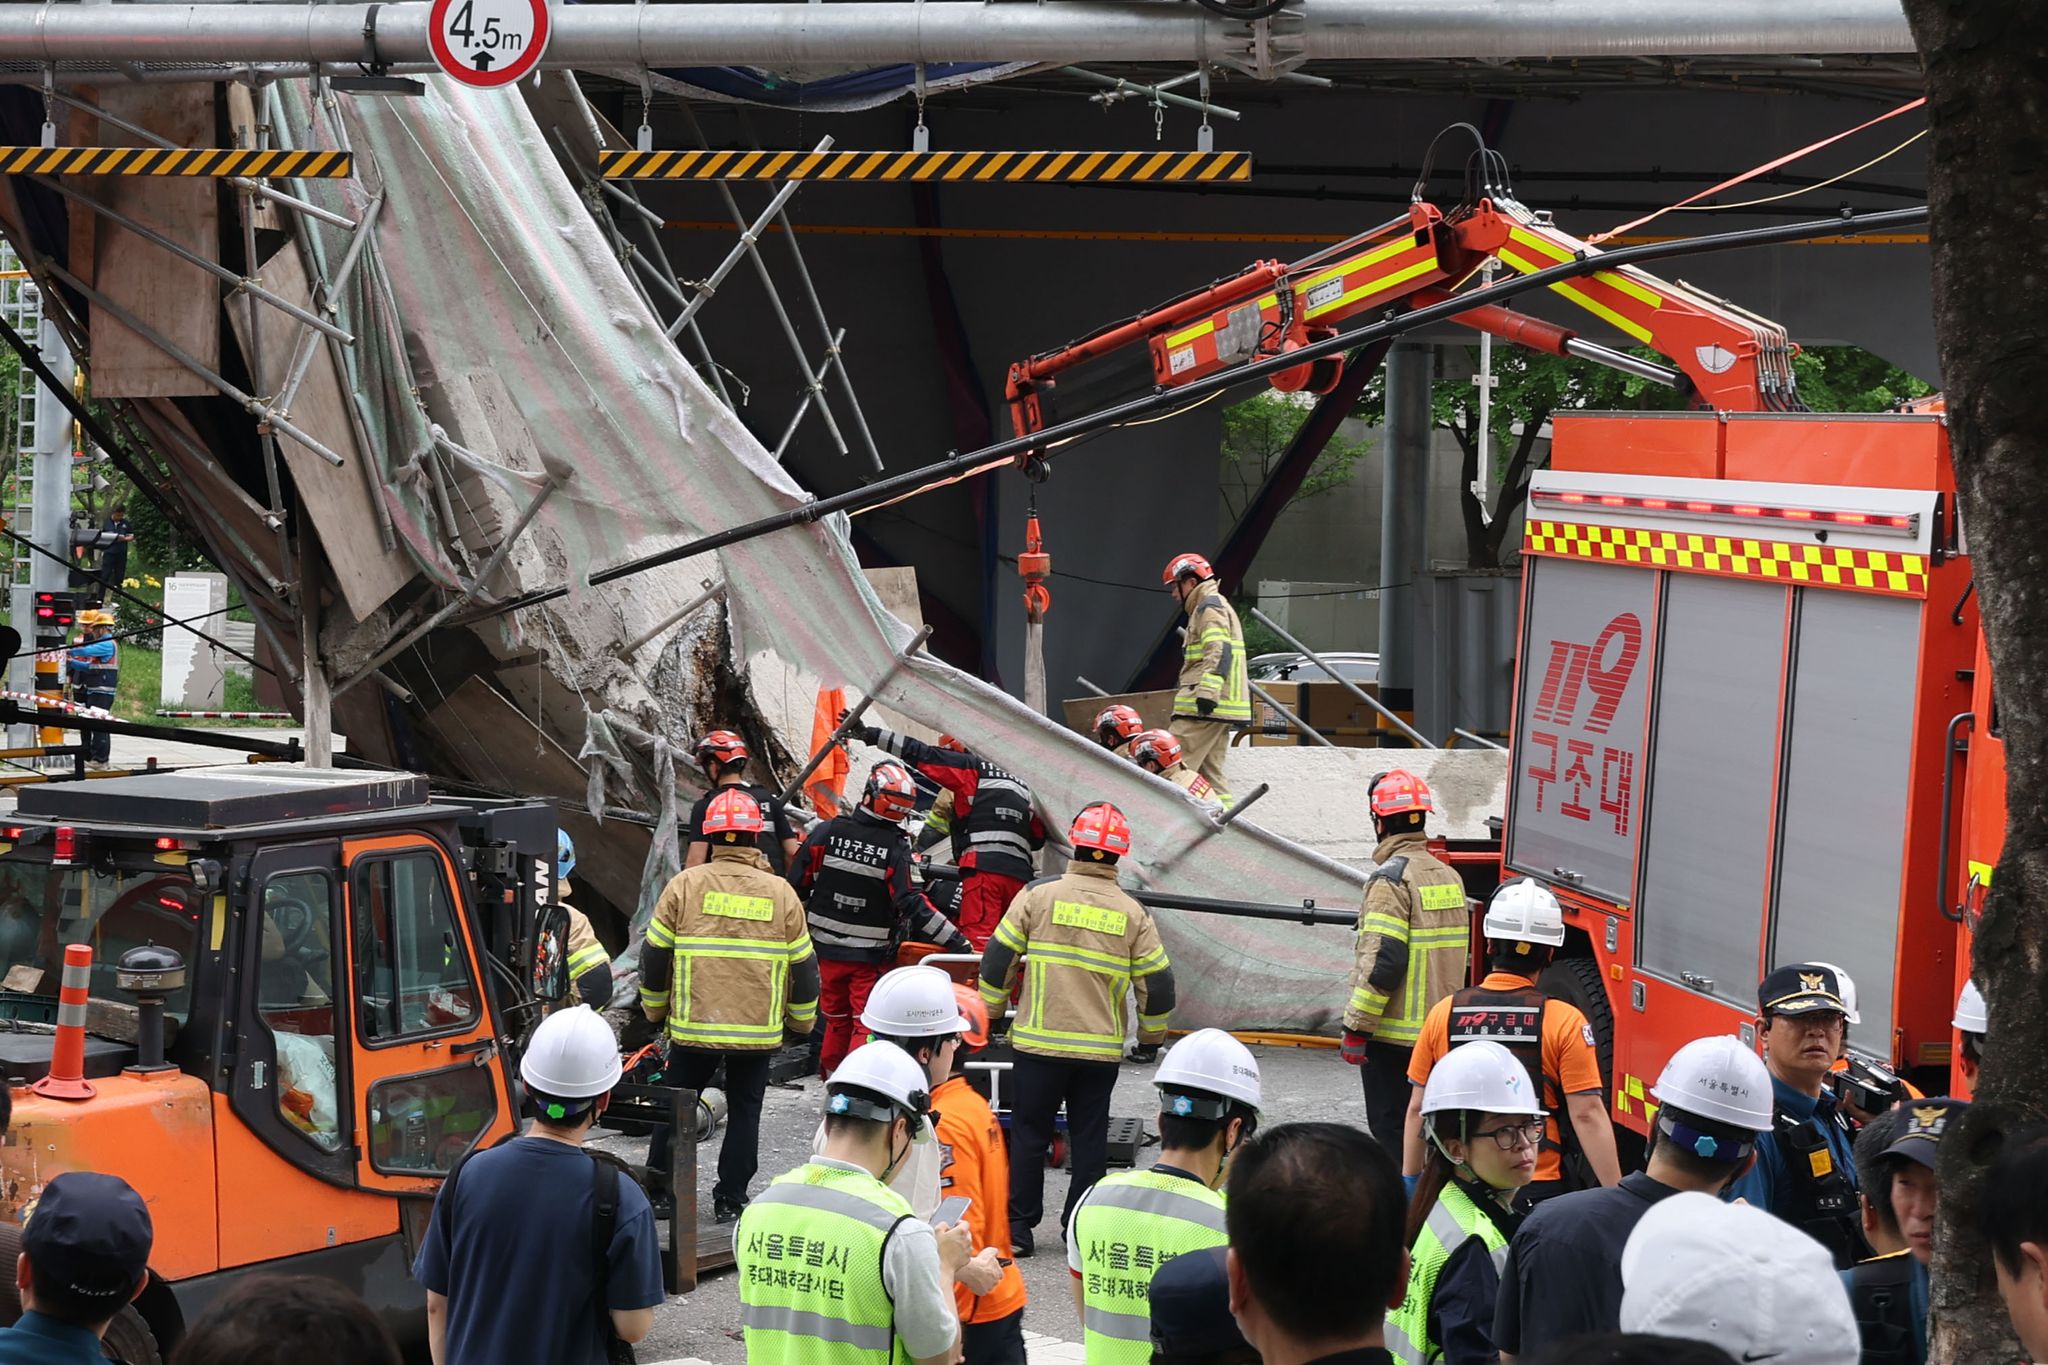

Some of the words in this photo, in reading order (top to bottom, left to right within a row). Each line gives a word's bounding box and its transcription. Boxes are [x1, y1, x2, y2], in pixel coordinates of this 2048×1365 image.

[450, 0, 522, 50] 4.5m
[1533, 612, 1642, 735] 119
[1528, 731, 1634, 837] 구조대
[829, 836, 889, 860] 119구조대
[834, 848, 878, 866] RESCUE
[1698, 1077, 1749, 1098] 서울특별시
[747, 1231, 850, 1275] 서울특별시
